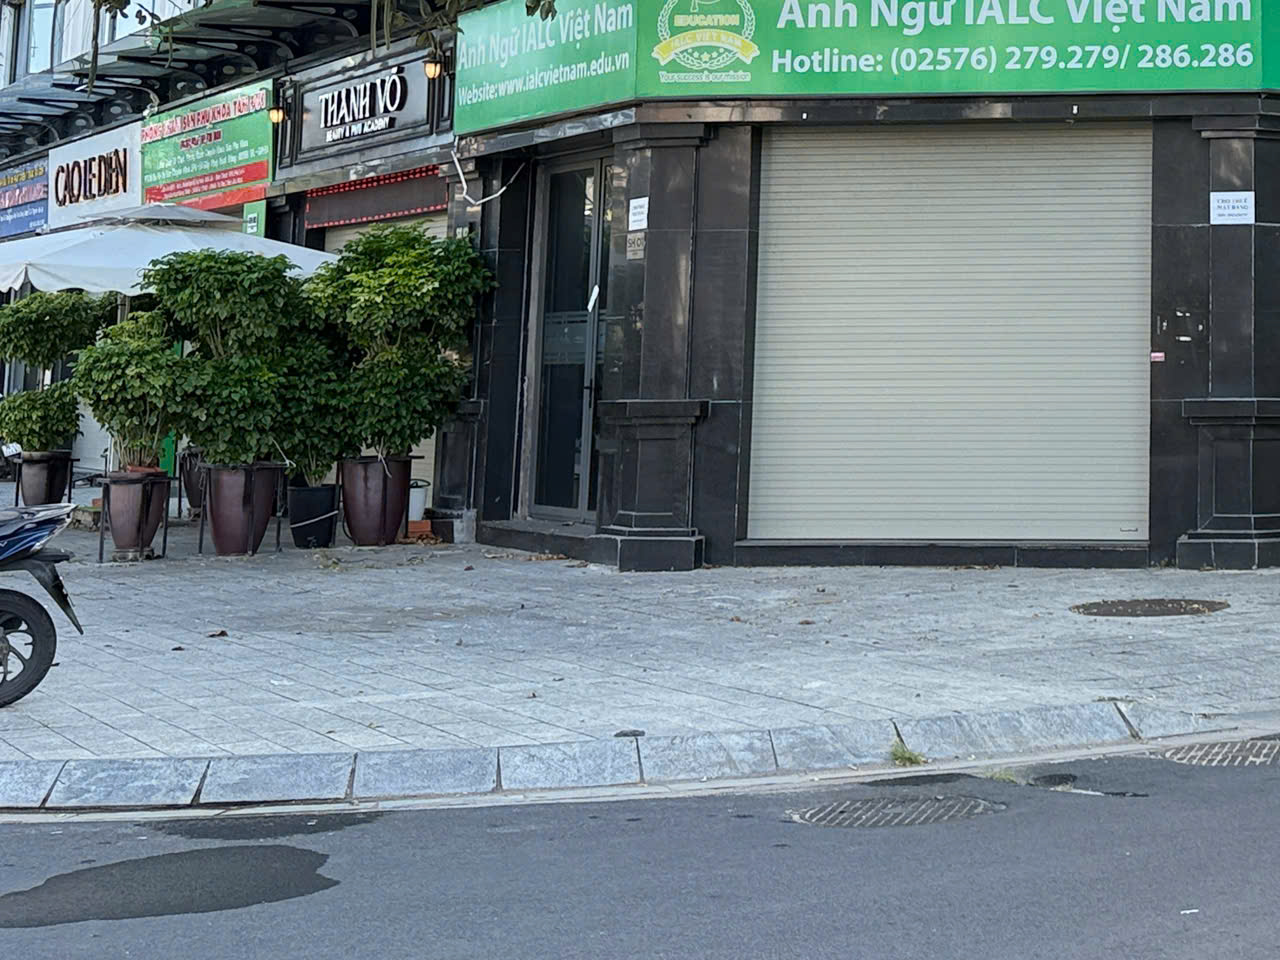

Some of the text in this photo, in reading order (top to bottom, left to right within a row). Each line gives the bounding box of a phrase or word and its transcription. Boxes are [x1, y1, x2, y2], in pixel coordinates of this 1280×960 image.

[458, 40, 485, 71] Anh
[522, 14, 556, 55] IALC
[559, 6, 591, 50] Việt
[594, 1, 633, 35] Nam
[771, 43, 1253, 76] Hotline: (02576) 279.279/ 286.286
[319, 81, 371, 129] THANH
